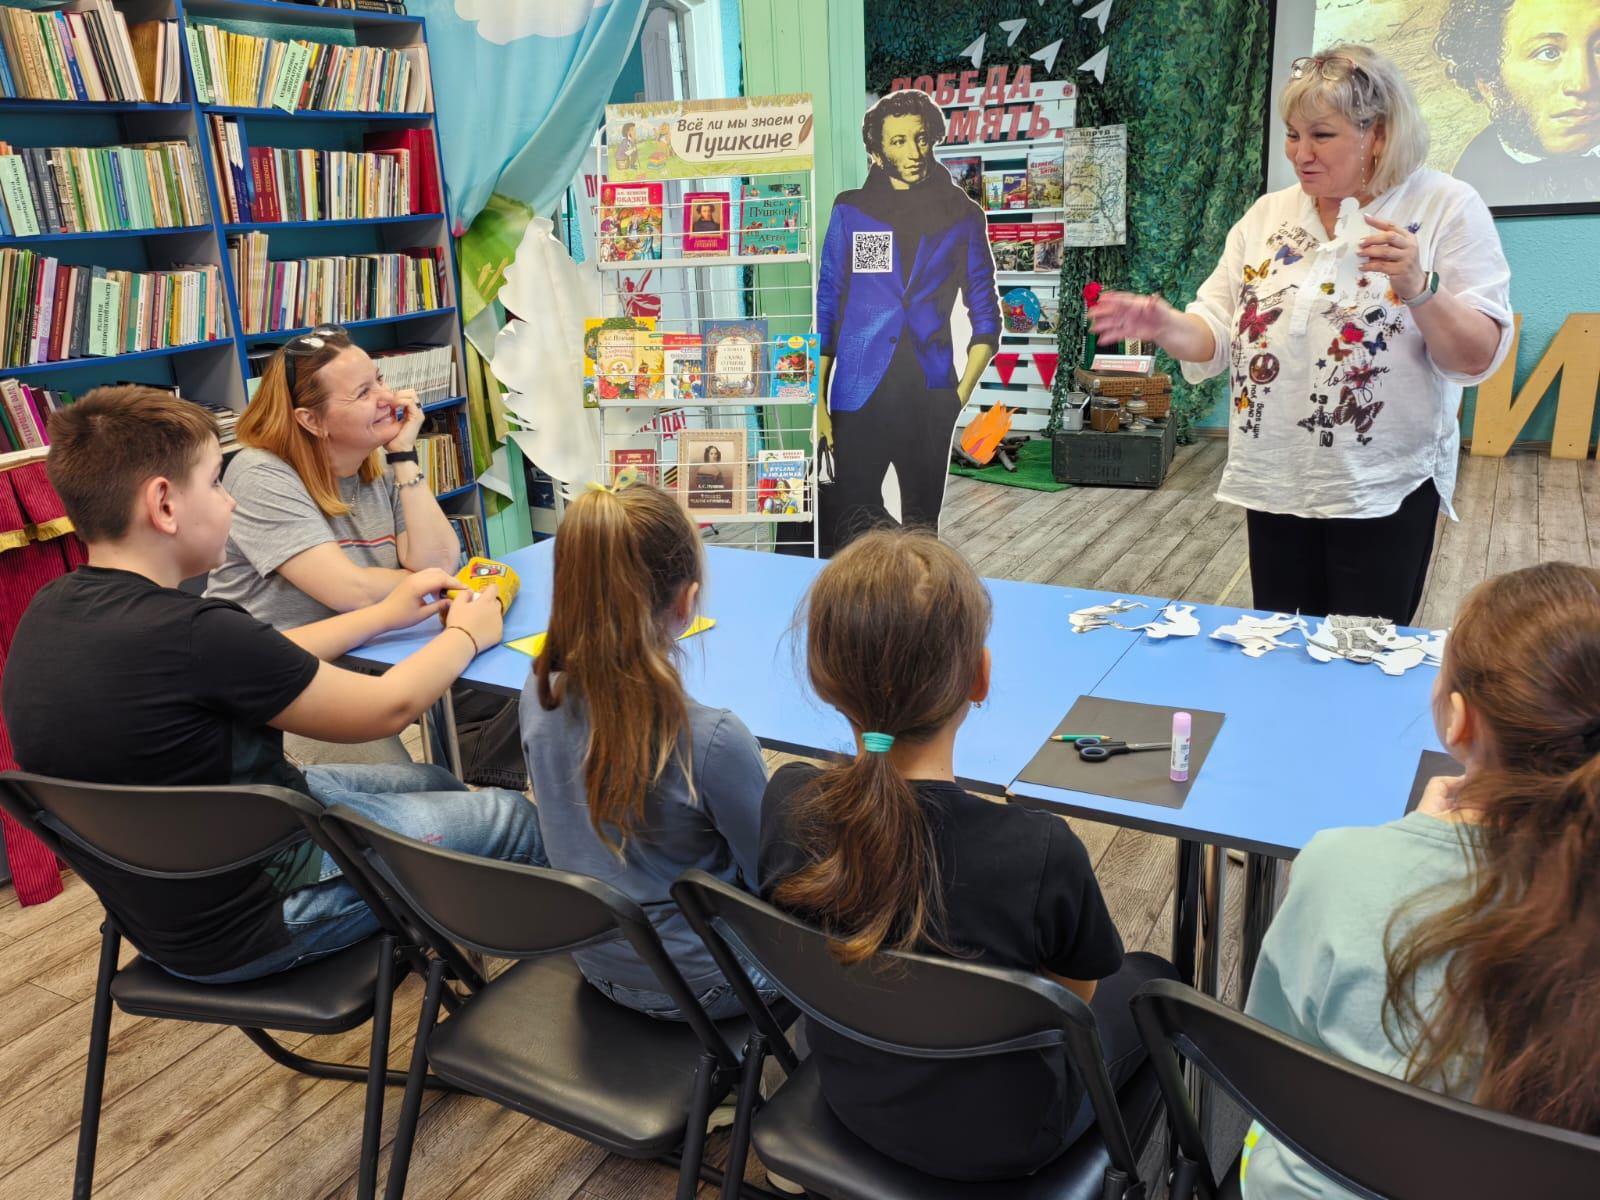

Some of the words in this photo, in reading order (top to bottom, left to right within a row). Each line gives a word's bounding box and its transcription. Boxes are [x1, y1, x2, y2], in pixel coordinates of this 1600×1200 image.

[677, 117, 704, 132] Всё
[707, 119, 723, 130] ли
[727, 119, 748, 129] мы
[751, 114, 794, 128] знаем
[798, 114, 807, 124] о
[685, 132, 793, 159] Пушкине
